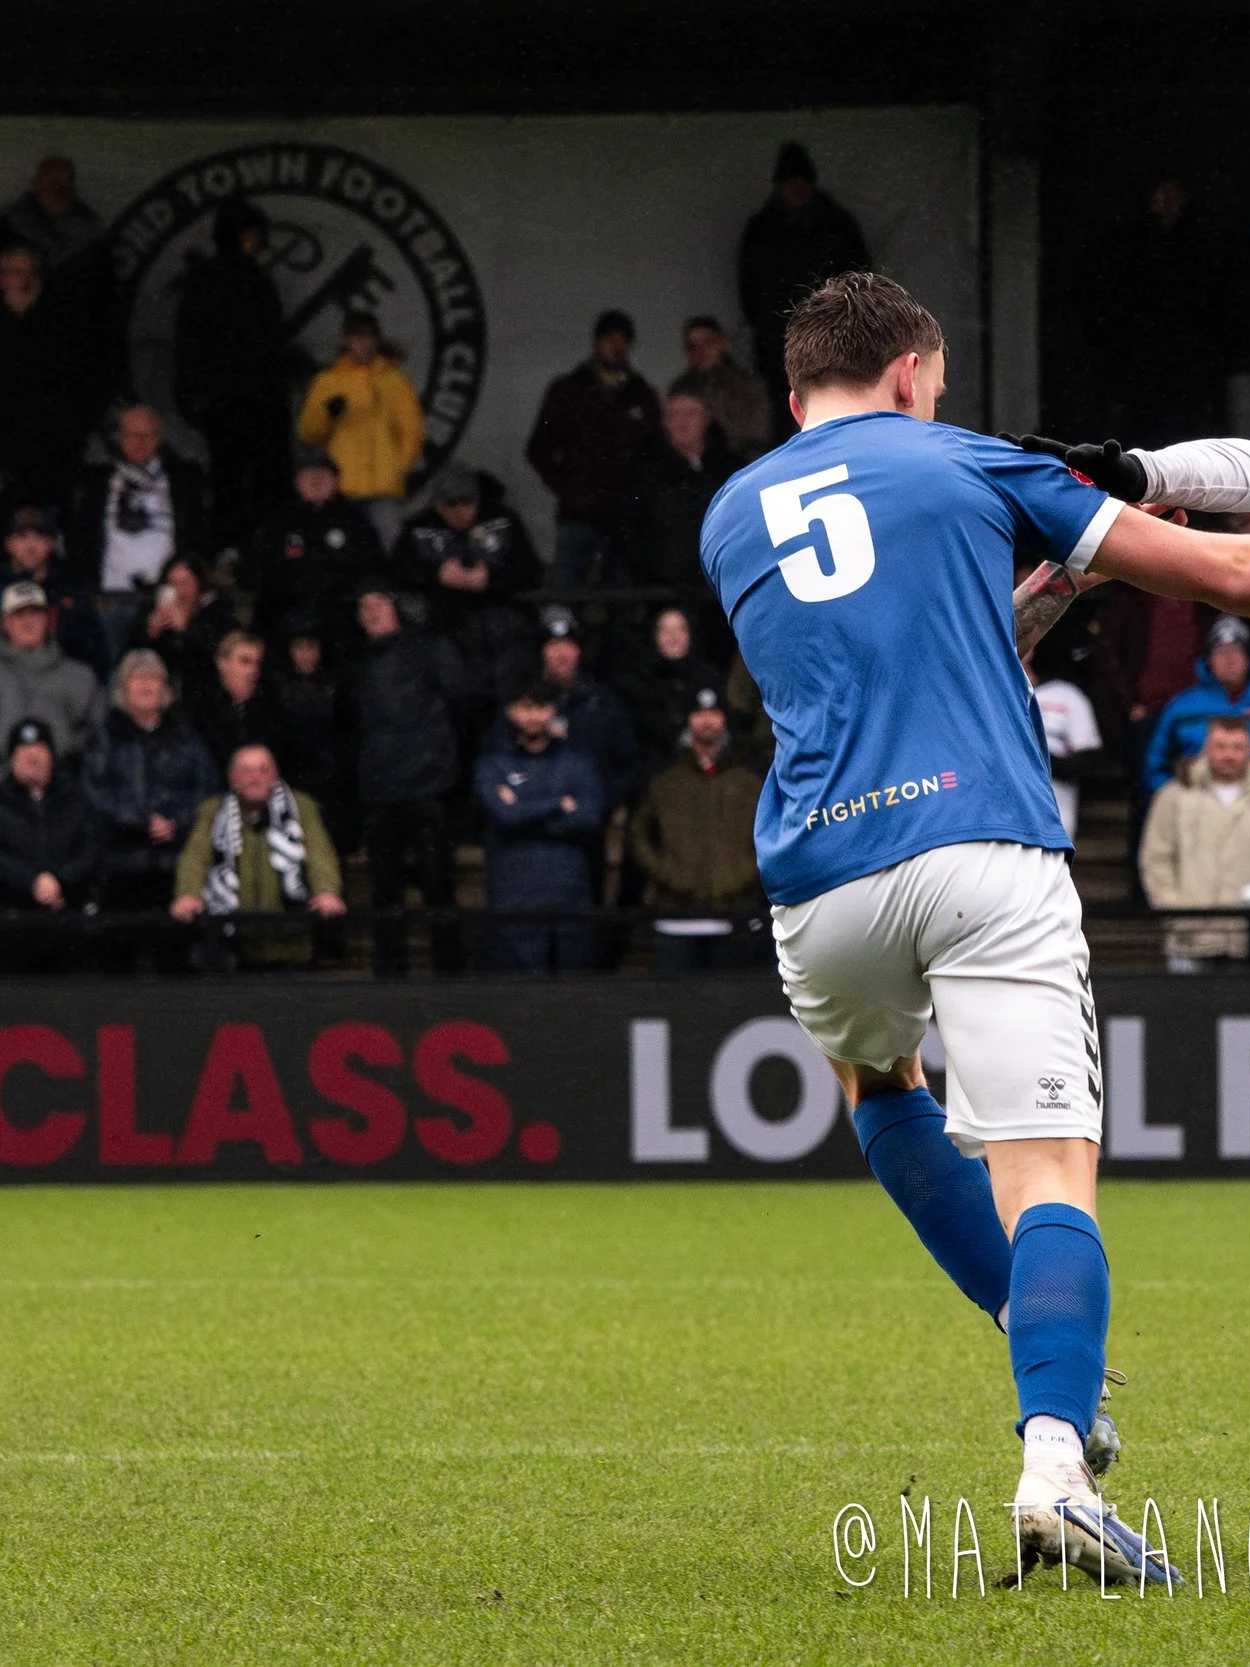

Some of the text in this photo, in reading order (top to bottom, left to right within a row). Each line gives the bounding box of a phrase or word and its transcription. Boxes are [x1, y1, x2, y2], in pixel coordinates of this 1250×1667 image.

[176, 152, 307, 207] TOWN
[320, 156, 476, 333] FOOTBALL
[426, 341, 477, 449] CLUB
[759, 464, 876, 603] 5
[806, 771, 958, 830] FIGHTZONE
[0, 1020, 563, 1165] CLASS.
[629, 1015, 1185, 1163] LOL
[1036, 1100, 1071, 1110] hummel
